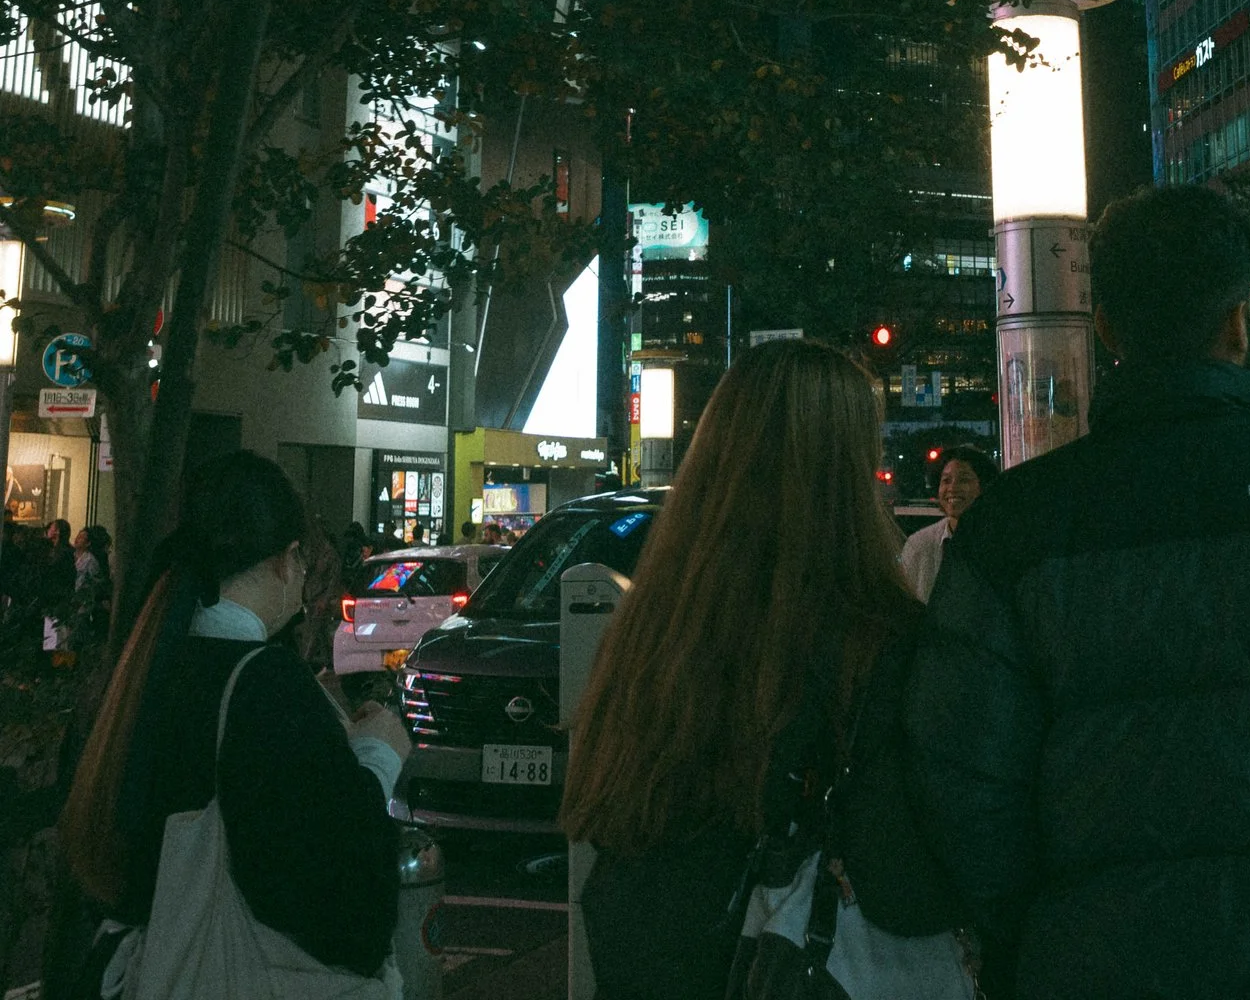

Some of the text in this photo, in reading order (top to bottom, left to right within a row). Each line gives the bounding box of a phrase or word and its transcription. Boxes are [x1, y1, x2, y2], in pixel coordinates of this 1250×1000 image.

[1196, 36, 1215, 68] ガスト
[500, 761, 548, 782] 14-88
